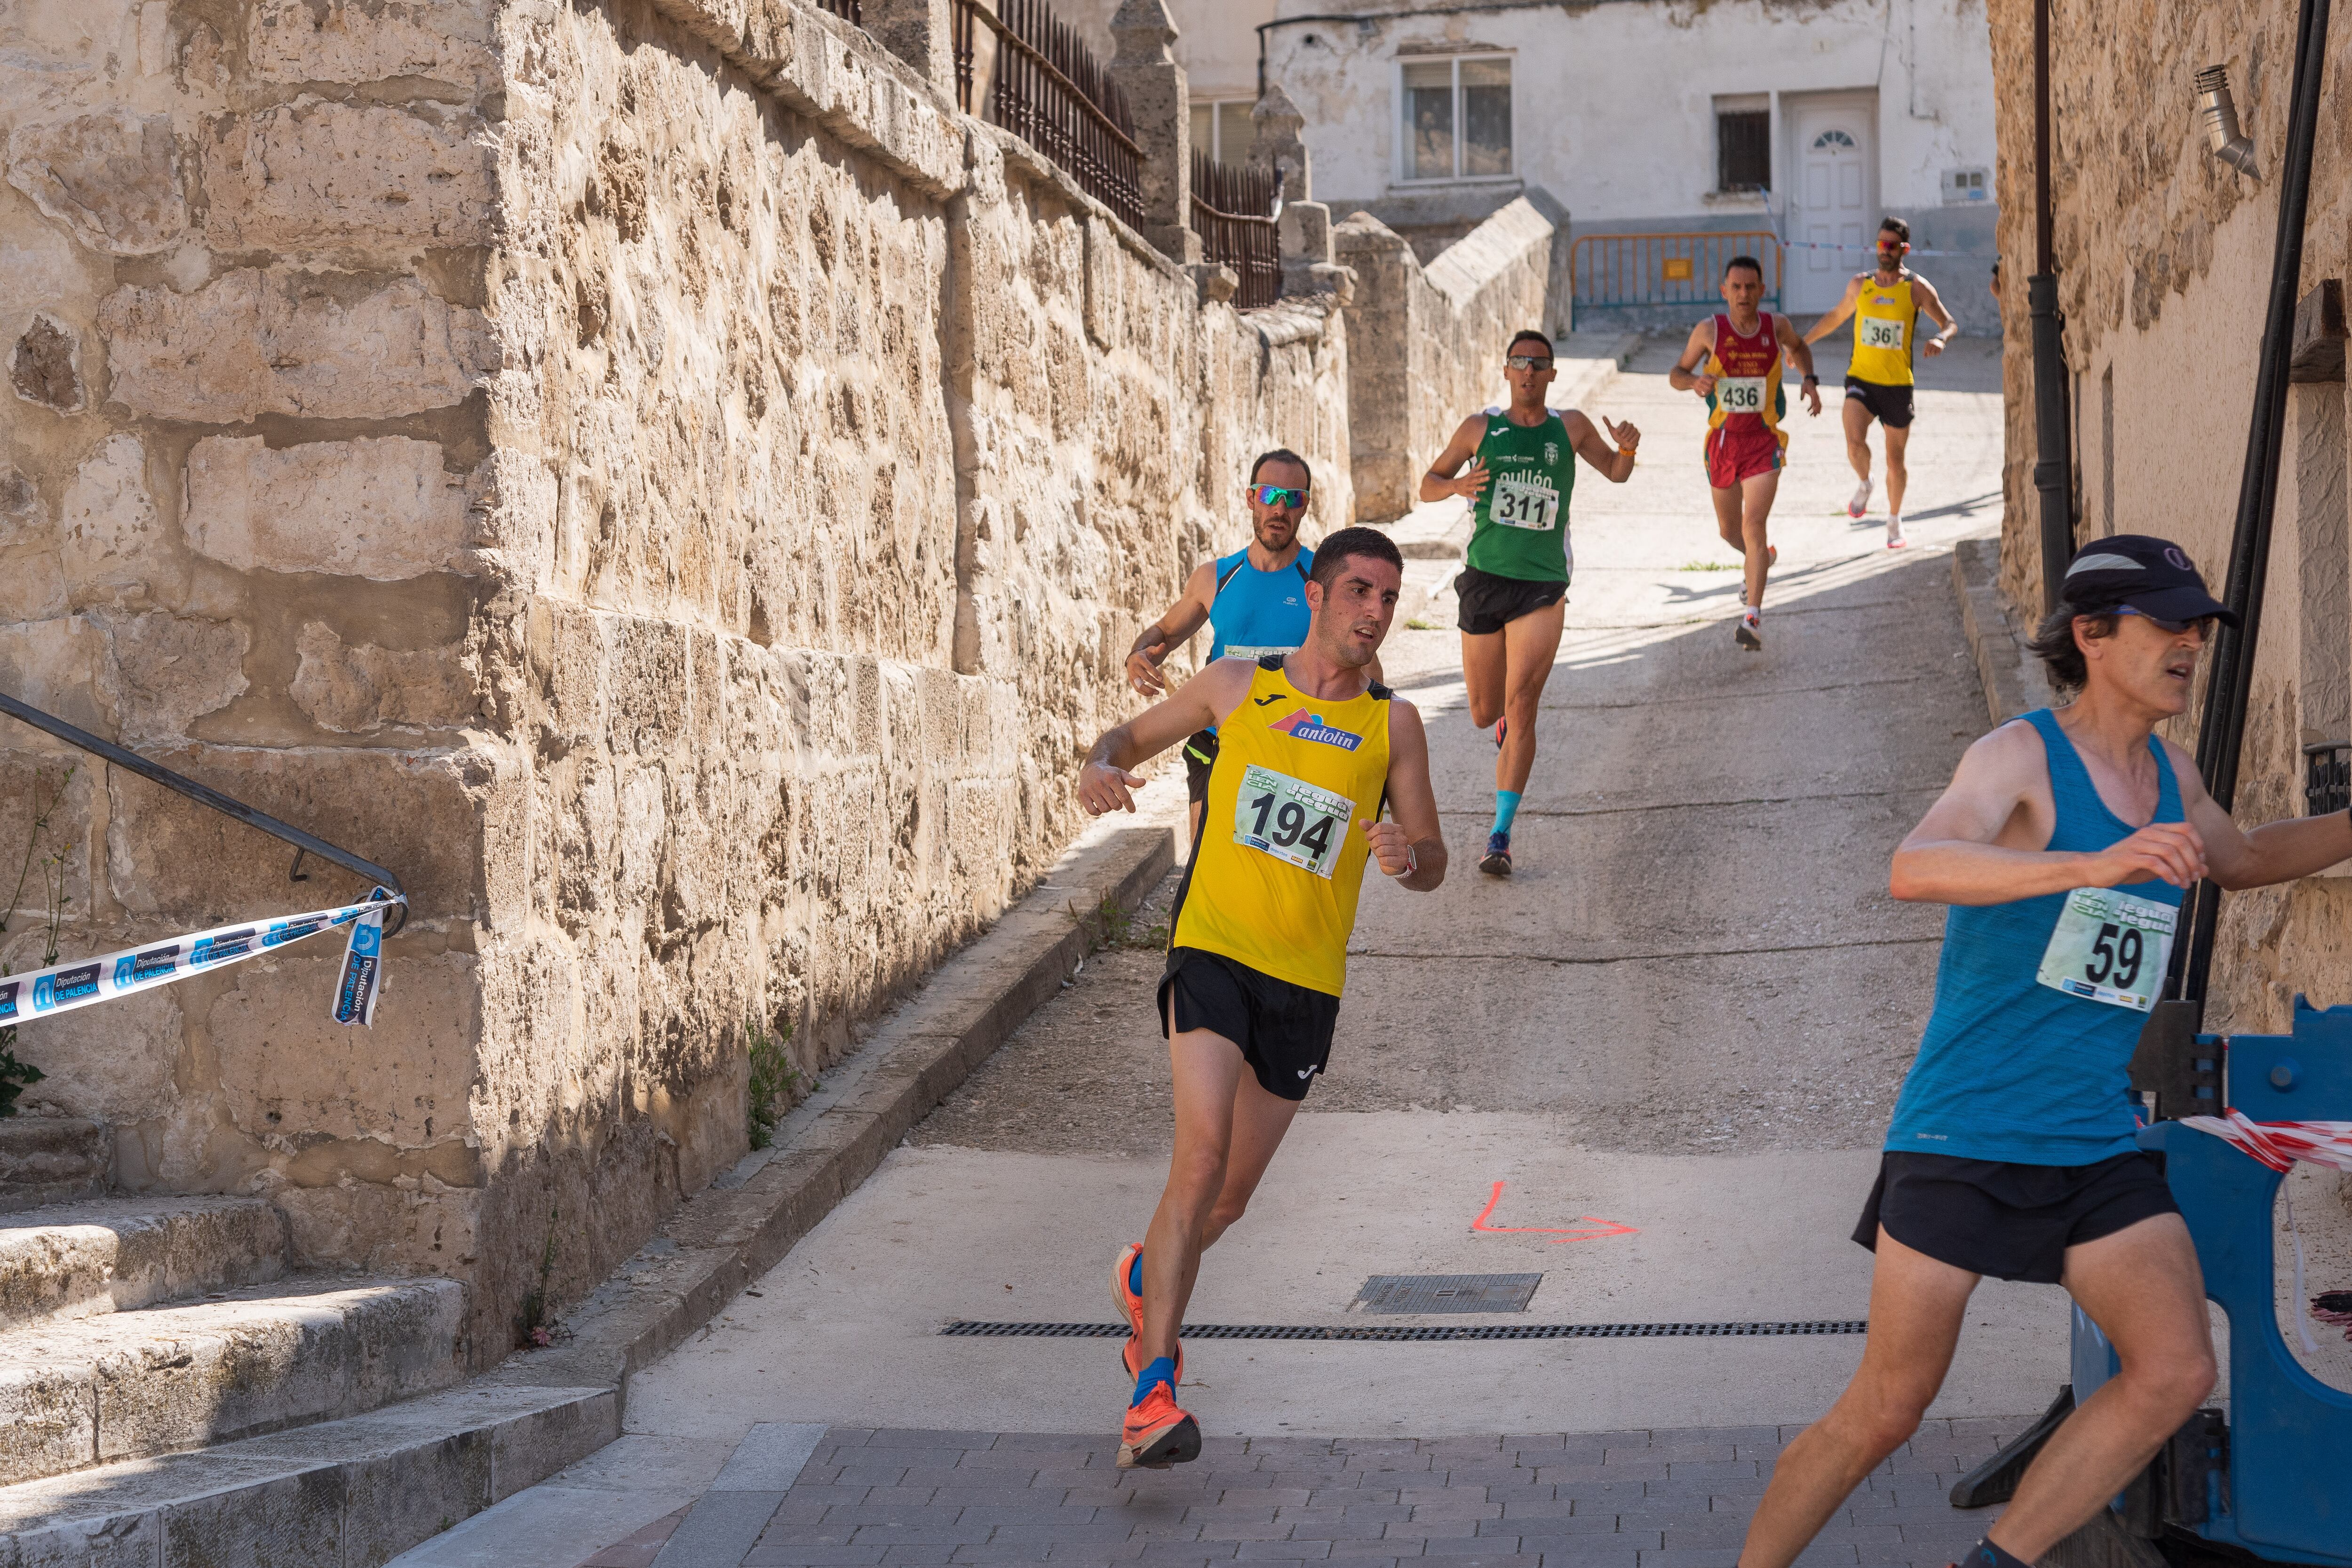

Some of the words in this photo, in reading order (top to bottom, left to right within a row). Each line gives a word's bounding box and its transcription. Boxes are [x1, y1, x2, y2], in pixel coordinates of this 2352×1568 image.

[1871, 325, 1891, 343] 36
[1724, 387, 1758, 406] 436
[1500, 493, 1545, 523] 311
[1298, 727, 1353, 748] antolin
[1247, 780, 1276, 793] CIA
[1248, 774, 1277, 787] LEN
[1291, 783, 1347, 812] legua
[1250, 792, 1335, 860] 194
[2119, 900, 2172, 923] legua
[136, 954, 170, 968] Diputación
[351, 955, 361, 970] DE
[2085, 923, 2144, 989] 59
[56, 971, 91, 988] Diputación
[134, 971, 144, 981] DE
[144, 963, 175, 979] PALENCIA
[55, 991, 65, 1002] DE
[65, 983, 98, 998] PALENCIA
[354, 960, 371, 1012] Diputación
[340, 971, 358, 1021] PALENCIA
